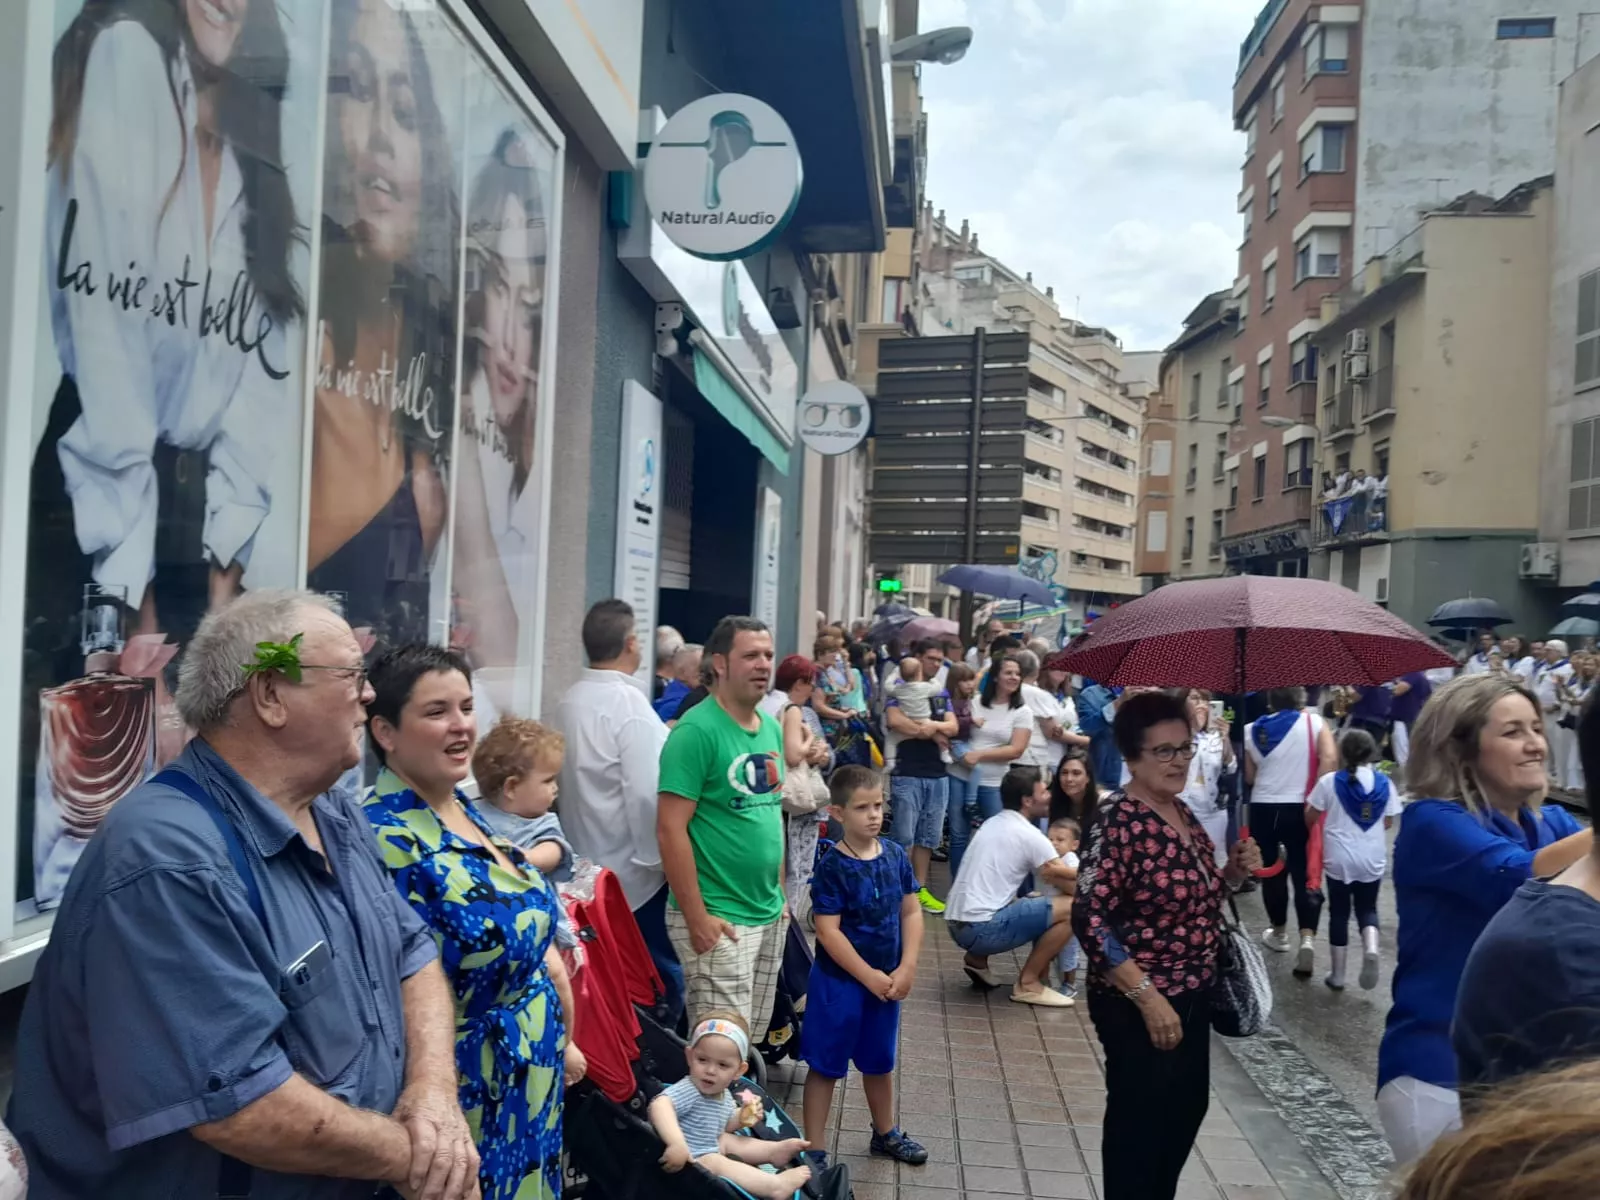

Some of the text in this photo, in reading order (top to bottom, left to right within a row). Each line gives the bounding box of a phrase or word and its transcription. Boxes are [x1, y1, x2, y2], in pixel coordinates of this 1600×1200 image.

[661, 210, 777, 225] Natural Audio
[57, 198, 290, 380] La vie est belle
[364, 349, 393, 407] est
[391, 352, 444, 439] belle
